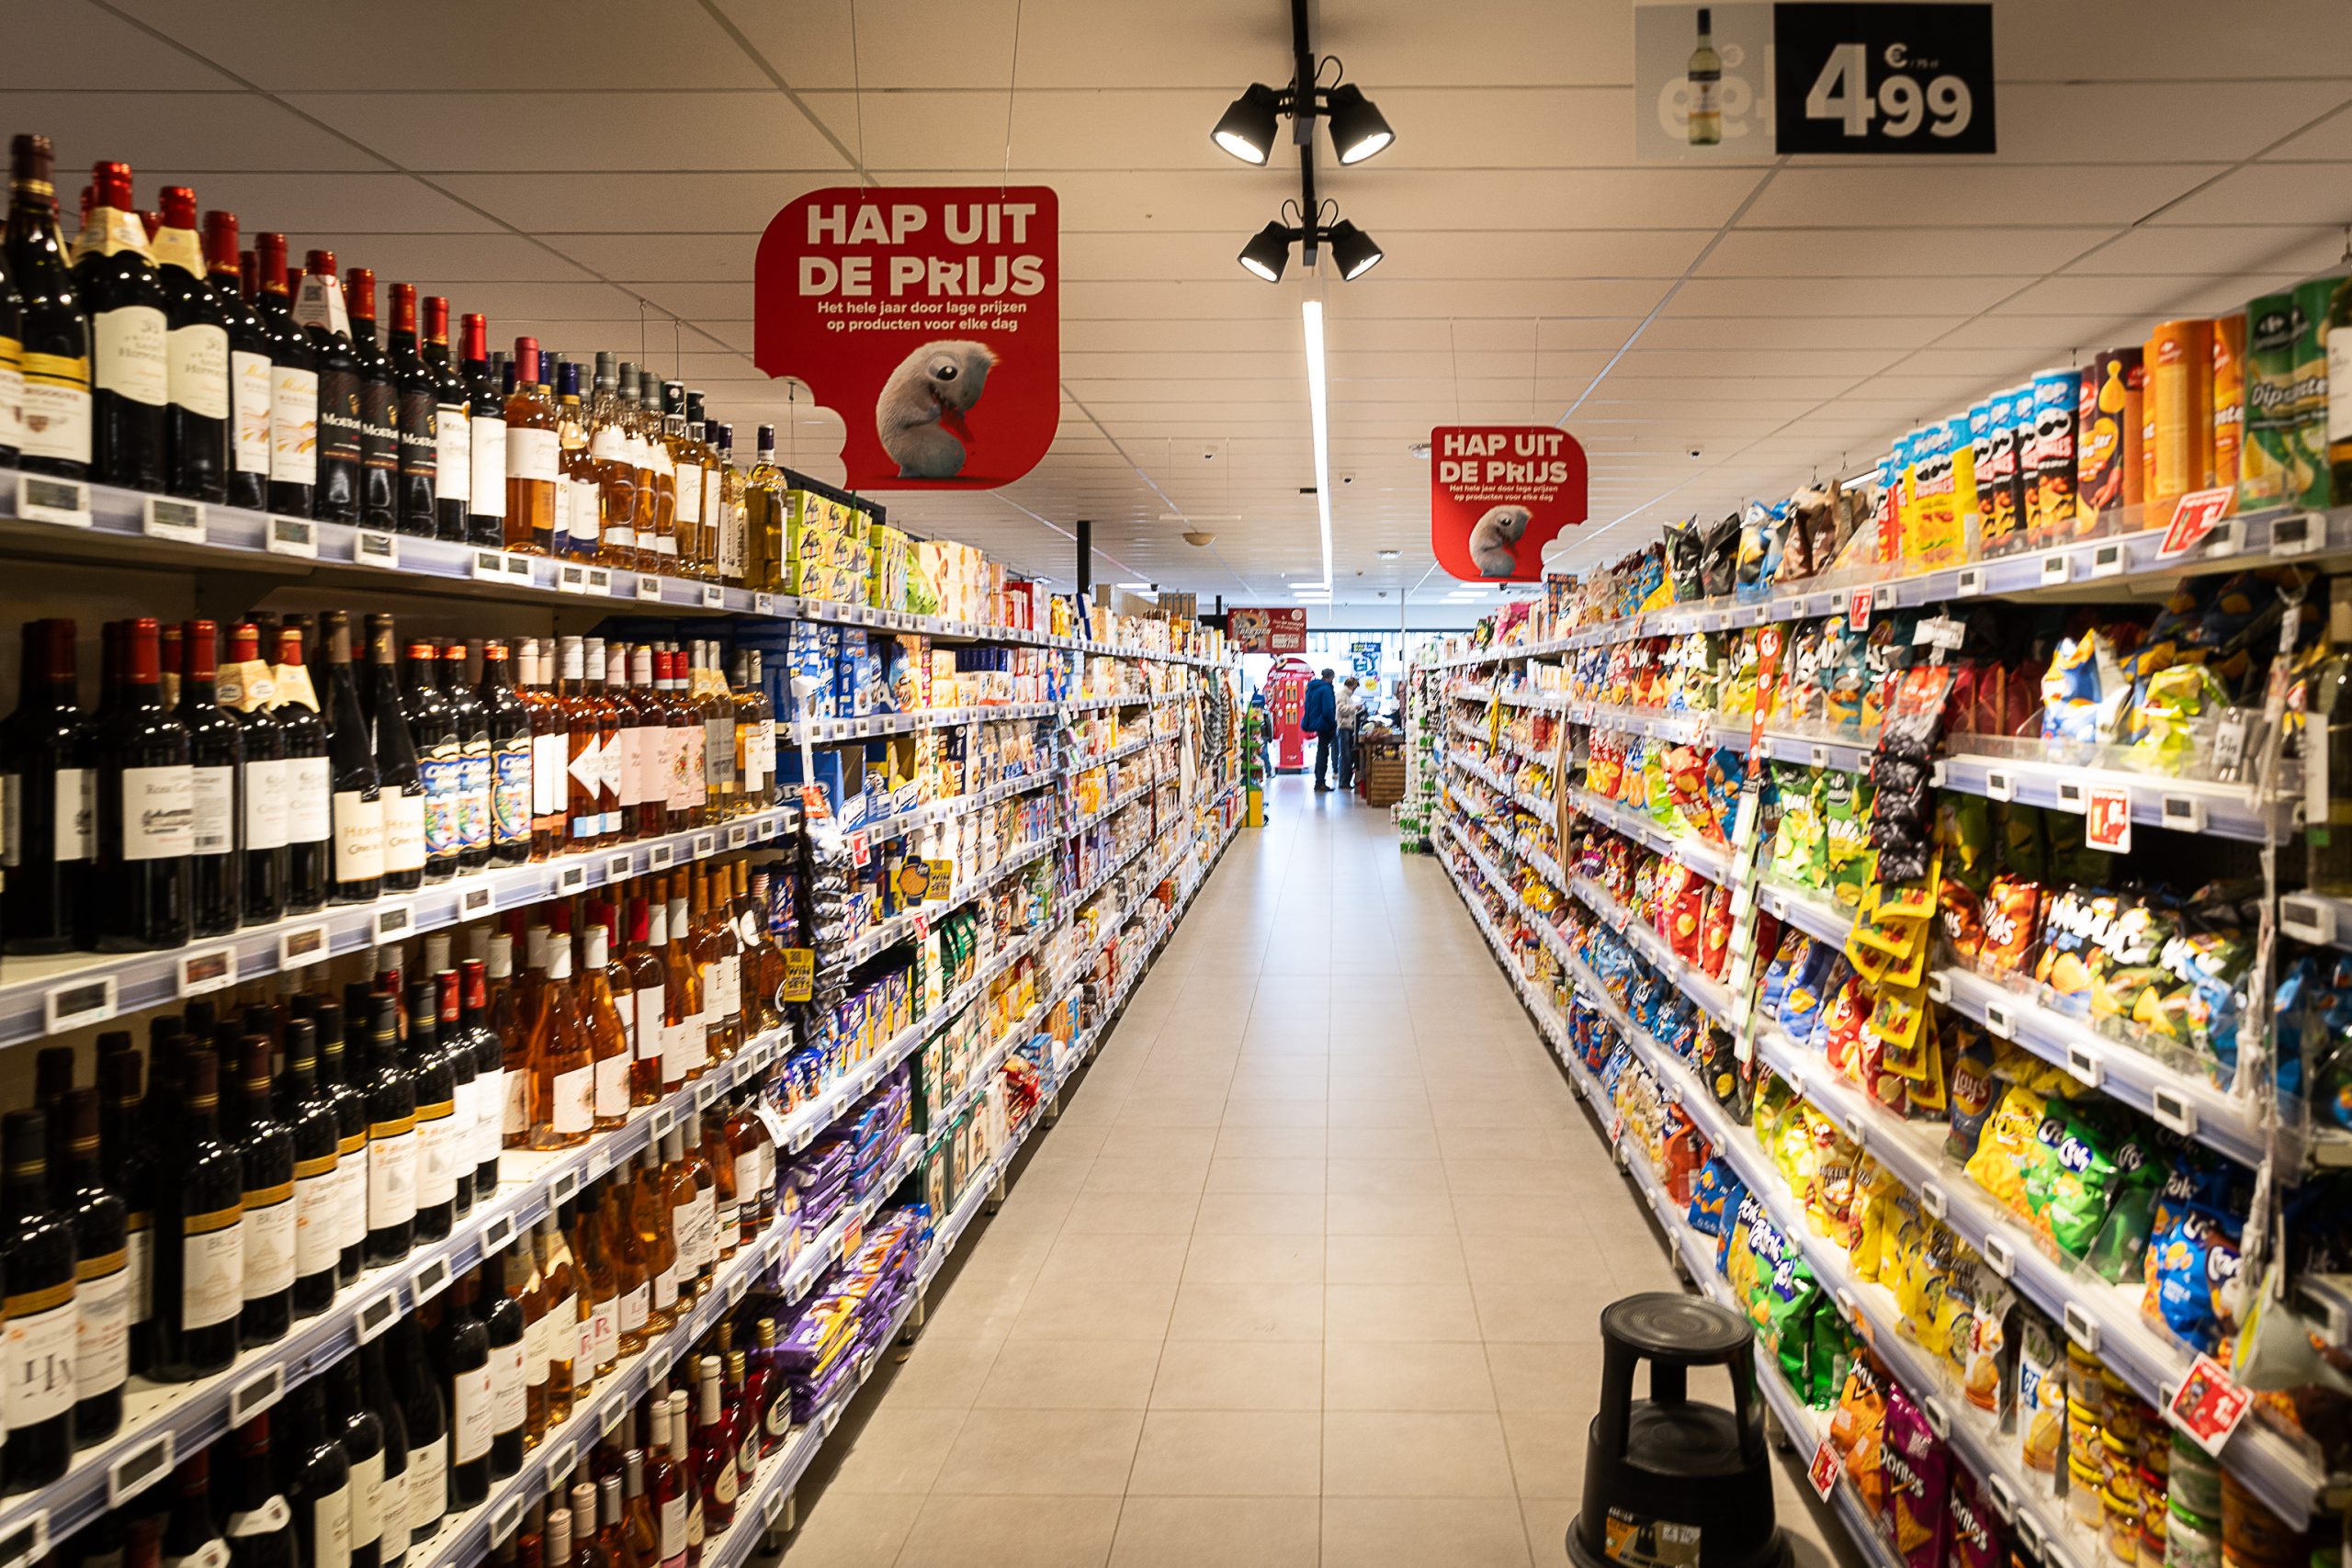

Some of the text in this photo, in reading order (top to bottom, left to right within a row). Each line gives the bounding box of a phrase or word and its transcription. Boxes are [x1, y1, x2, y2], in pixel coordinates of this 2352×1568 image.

[1883, 43, 1908, 69] €
[808, 203, 1036, 244] HAP UIT
[798, 254, 1046, 297] DE PRIJS
[818, 301, 1027, 317] Het hele jaar door lage prijzen
[827, 318, 1018, 333] op producten voor elke dag
[1444, 434, 1564, 457] HAP UIT
[1440, 460, 1568, 483] DE PRIJS
[1449, 484, 1558, 493] Het hele jaar door lage prijzen
[1454, 494, 1464, 502] op
[1465, 493, 1503, 502] producten
[1522, 493, 1537, 502] elke
[1539, 493, 1554, 502] dag
